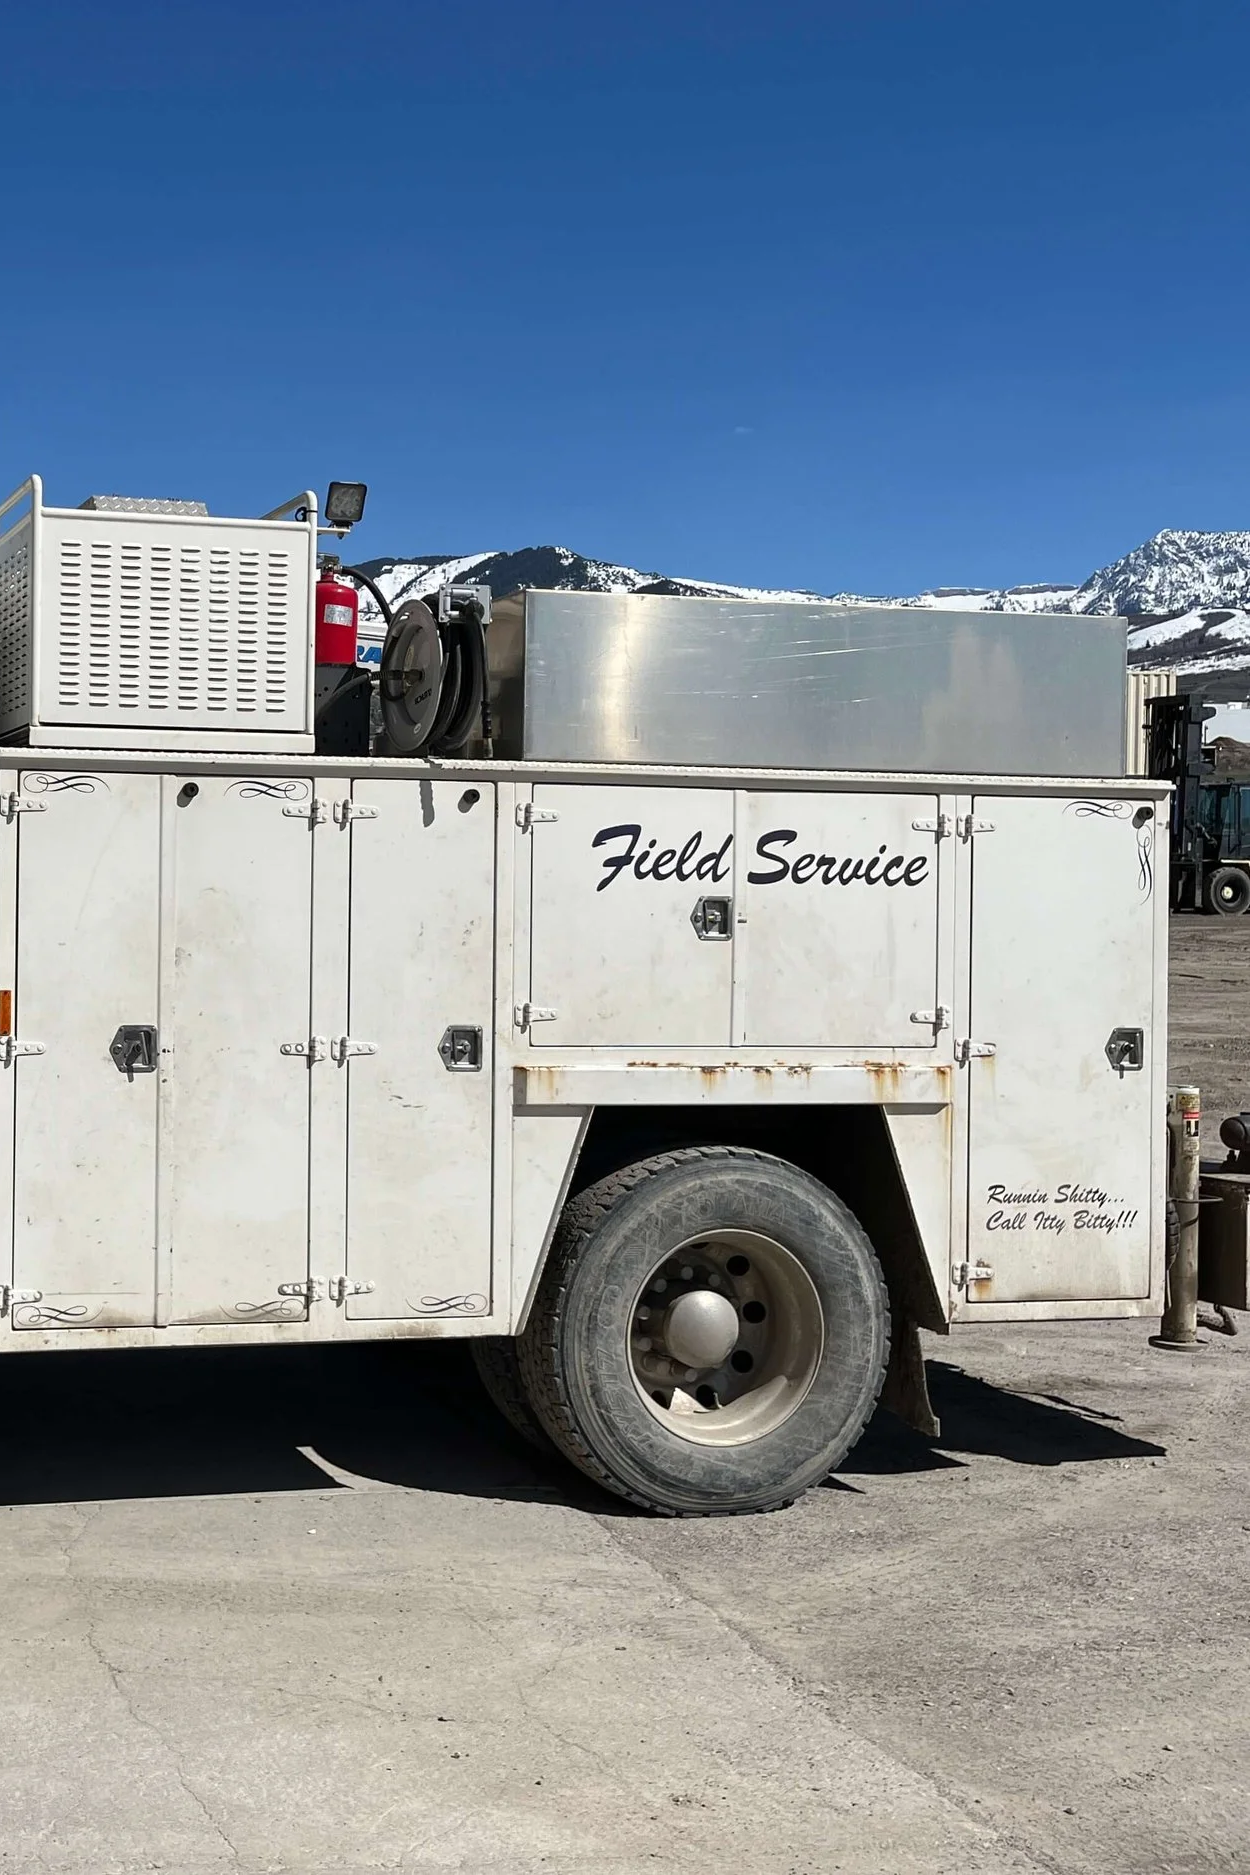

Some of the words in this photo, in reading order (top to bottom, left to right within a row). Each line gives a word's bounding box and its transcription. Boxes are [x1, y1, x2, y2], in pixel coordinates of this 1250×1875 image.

[592, 824, 734, 892] Field
[747, 829, 929, 887] Service
[986, 1184, 1049, 1205] Runnin
[1054, 1184, 1125, 1209] Shitty...
[985, 1210, 1028, 1231] Call
[1033, 1211, 1067, 1236] Itty
[1073, 1209, 1139, 1235] Bitty!!!
